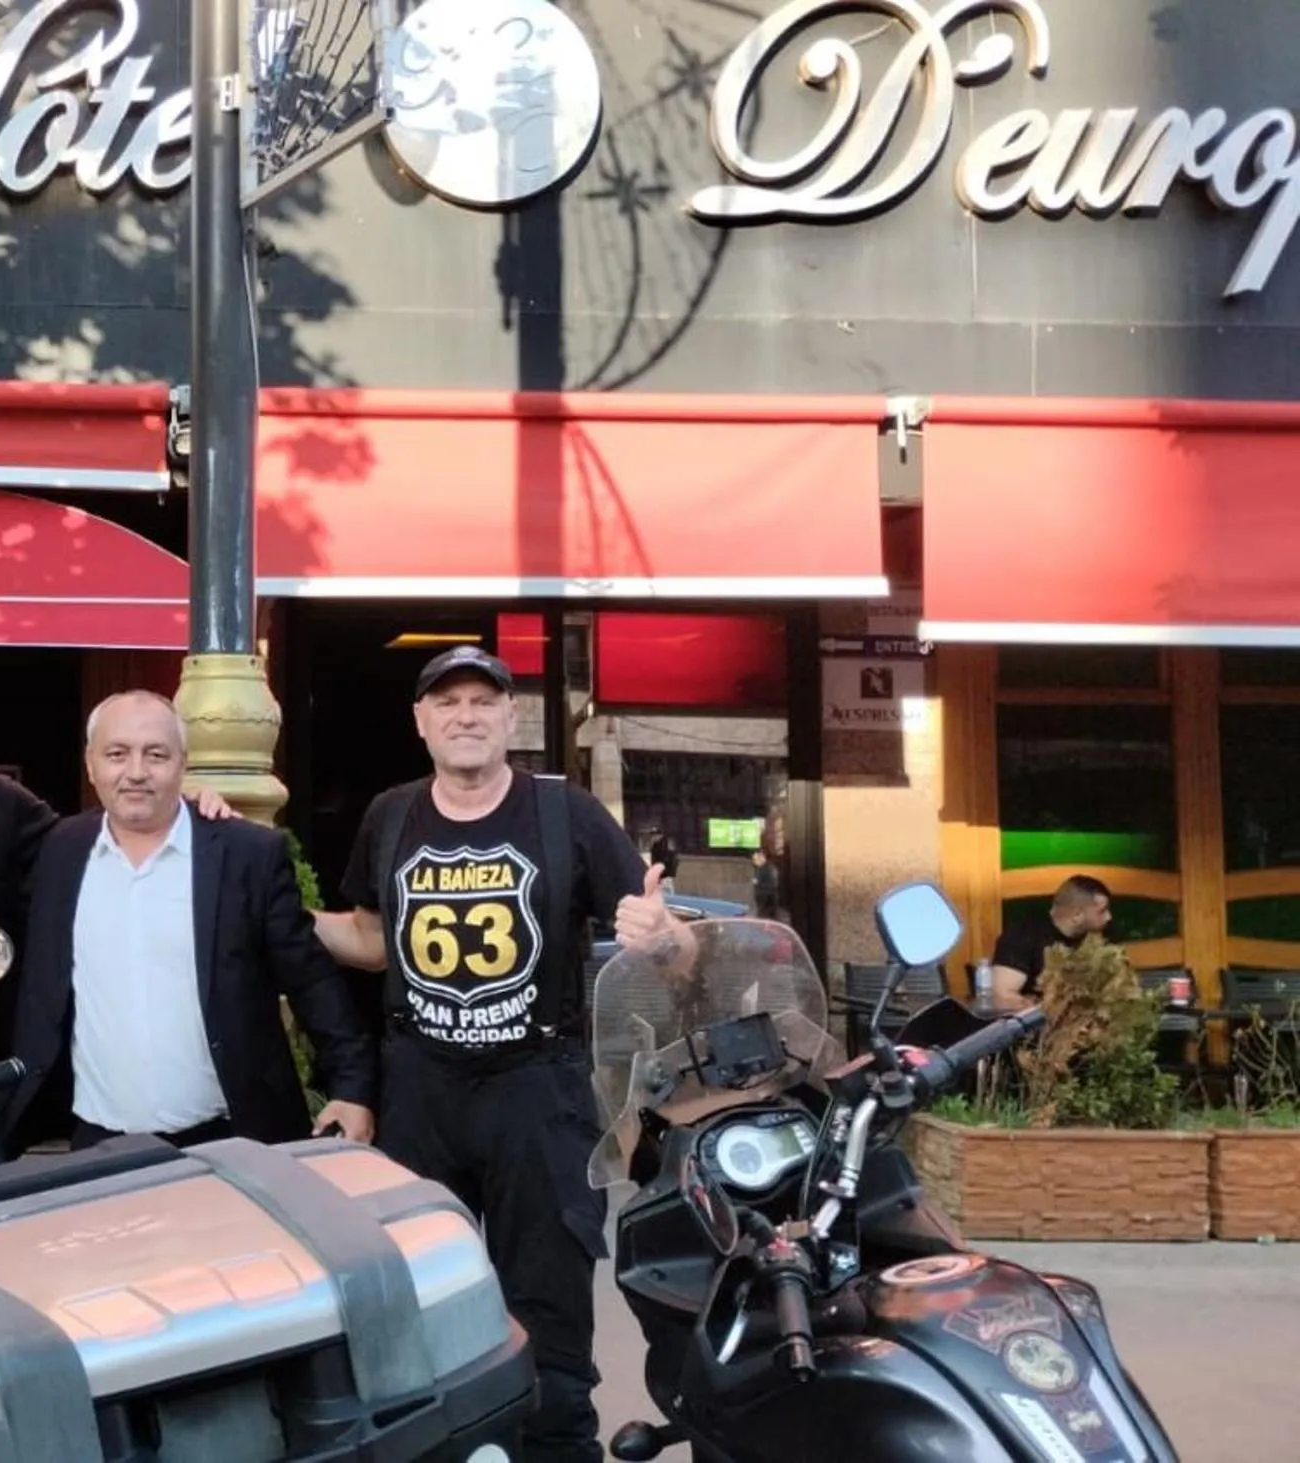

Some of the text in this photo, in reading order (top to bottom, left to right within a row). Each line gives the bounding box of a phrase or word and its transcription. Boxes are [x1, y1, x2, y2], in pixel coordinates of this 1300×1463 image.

[825, 702, 922, 724] NESPRES
[411, 862, 515, 891] LA BAÑEZA
[410, 902, 518, 978] 63
[458, 983, 538, 1028] PREMIO
